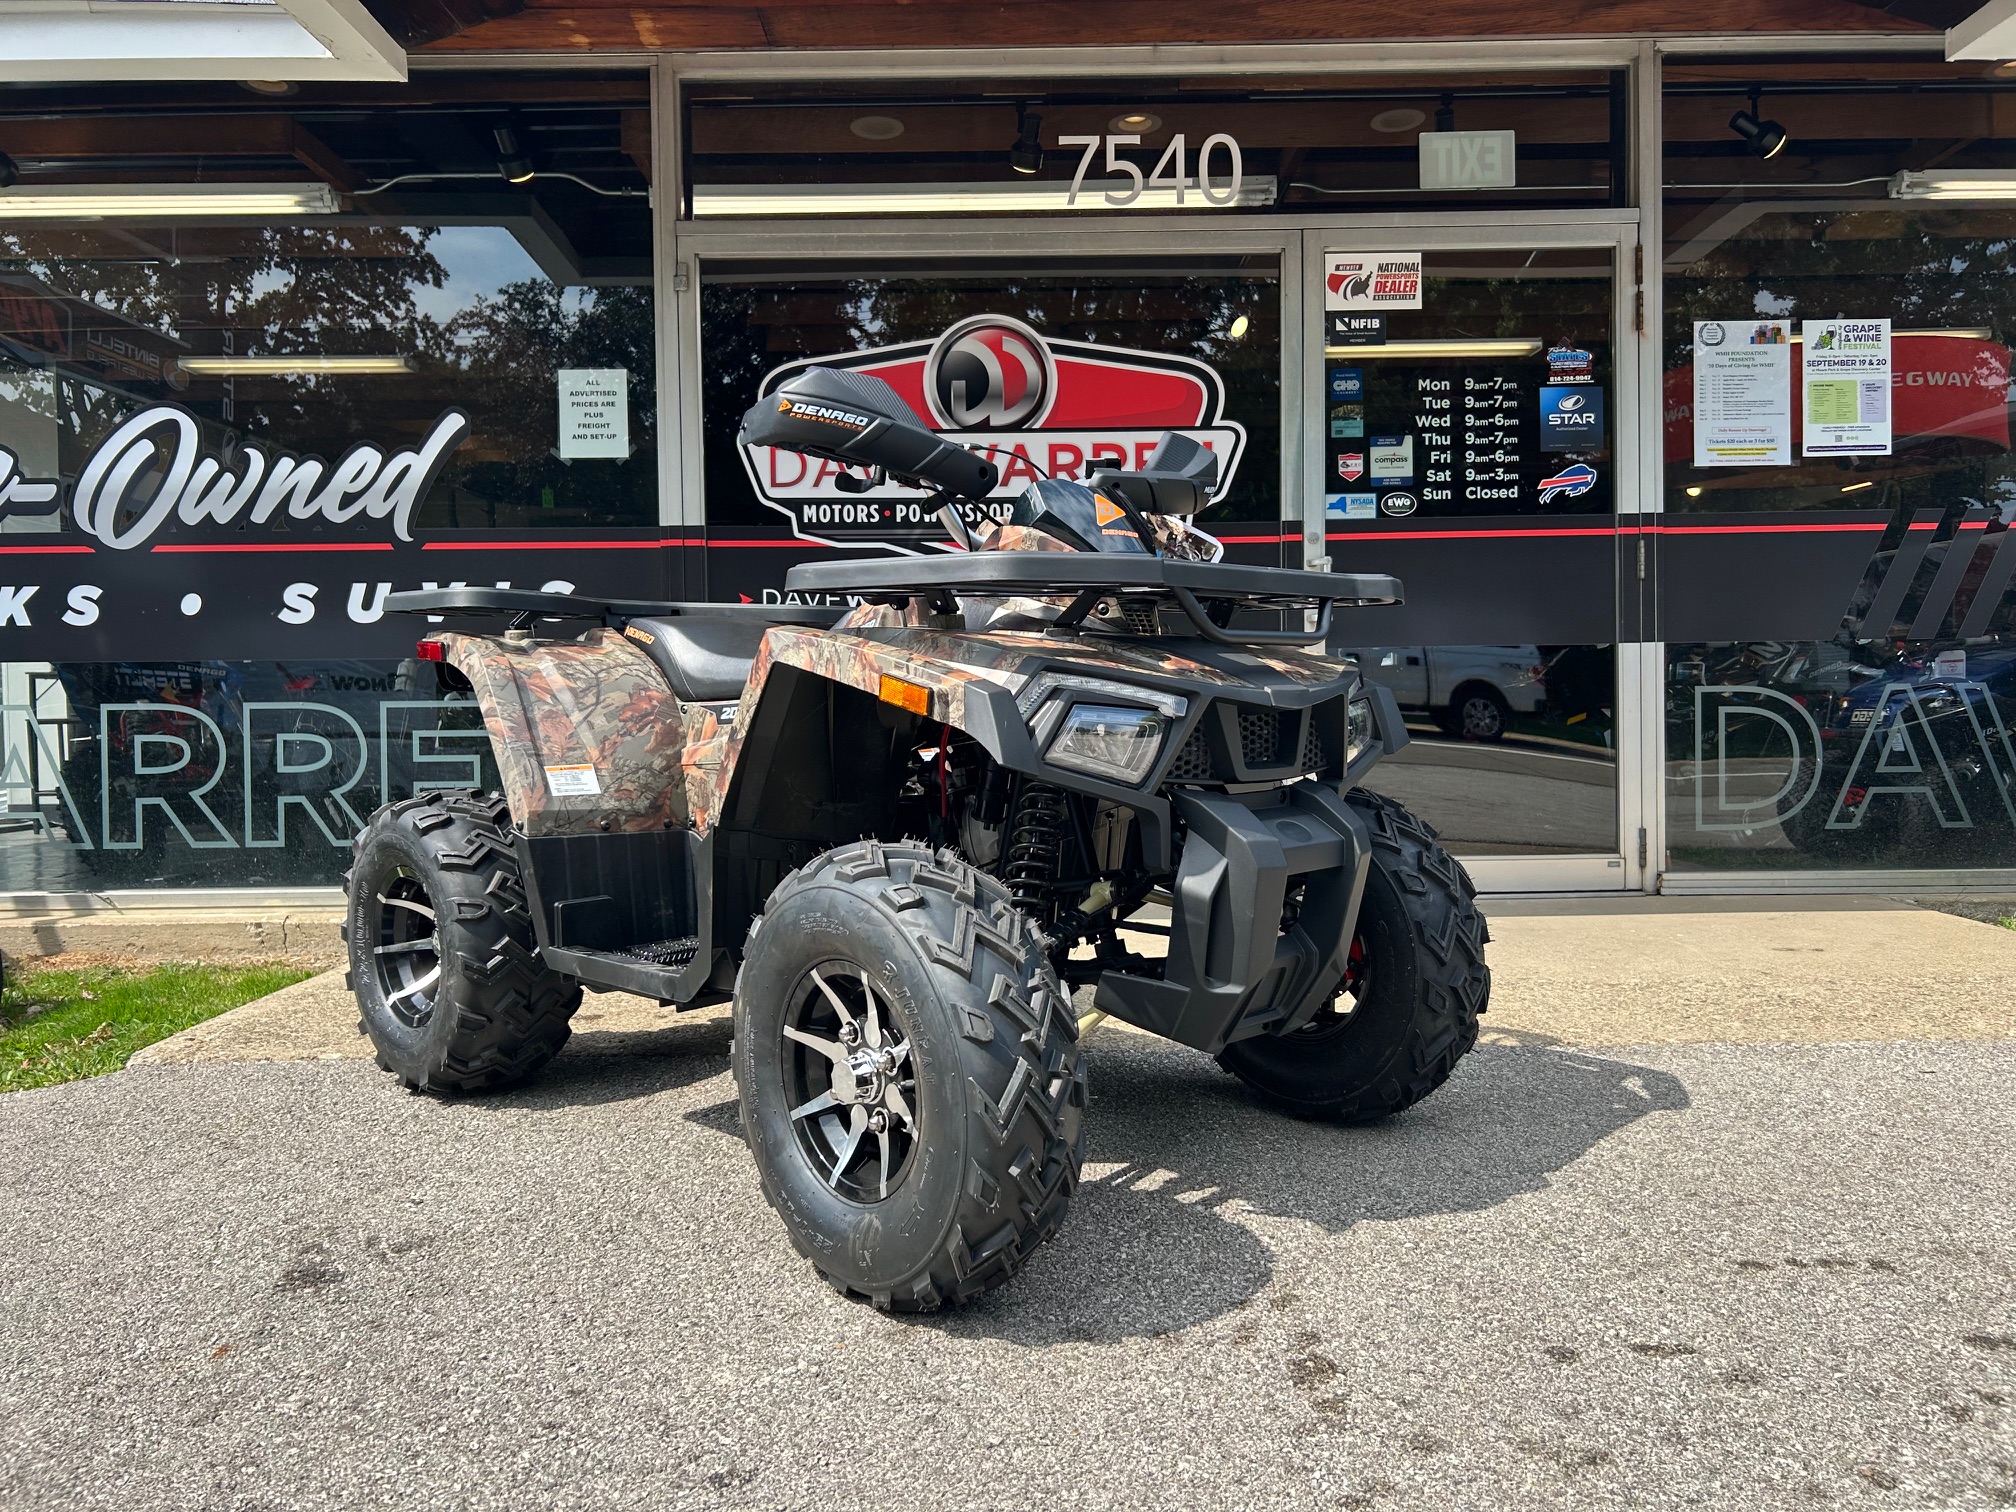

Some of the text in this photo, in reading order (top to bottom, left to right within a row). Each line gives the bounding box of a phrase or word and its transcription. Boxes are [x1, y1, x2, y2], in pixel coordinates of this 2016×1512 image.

[1058, 133, 1243, 206] 7540
[1377, 261, 1420, 273] NATIONAL
[1375, 272, 1419, 280] POWERSPORTS
[1373, 280, 1418, 294] DEALER
[1350, 318, 1380, 329] NFIB
[1843, 324, 1882, 334] GRAPE
[1853, 334, 1882, 342] WINE
[1806, 359, 1856, 367] SEPTEMBER
[1333, 380, 1360, 392] CHQ
[1418, 378, 1519, 391] Mon 9am-7pm
[1423, 396, 1519, 409] Tue 9am-7pm
[792, 402, 869, 426] DENAGO
[1548, 413, 1595, 424] STAR
[789, 413, 863, 431] POWERSPORTS
[1415, 415, 1519, 427] Wed 9am-6pm
[1422, 432, 1519, 445] Thu 9am-7pm
[1374, 456, 1408, 465] compass
[1430, 450, 1519, 464] Fri 9am-6pm
[1426, 468, 1519, 482] Sat 9am-3pm
[1423, 485, 1518, 500] Sun Closed
[1388, 497, 1411, 507] EWG
[803, 504, 880, 524] MOTORS
